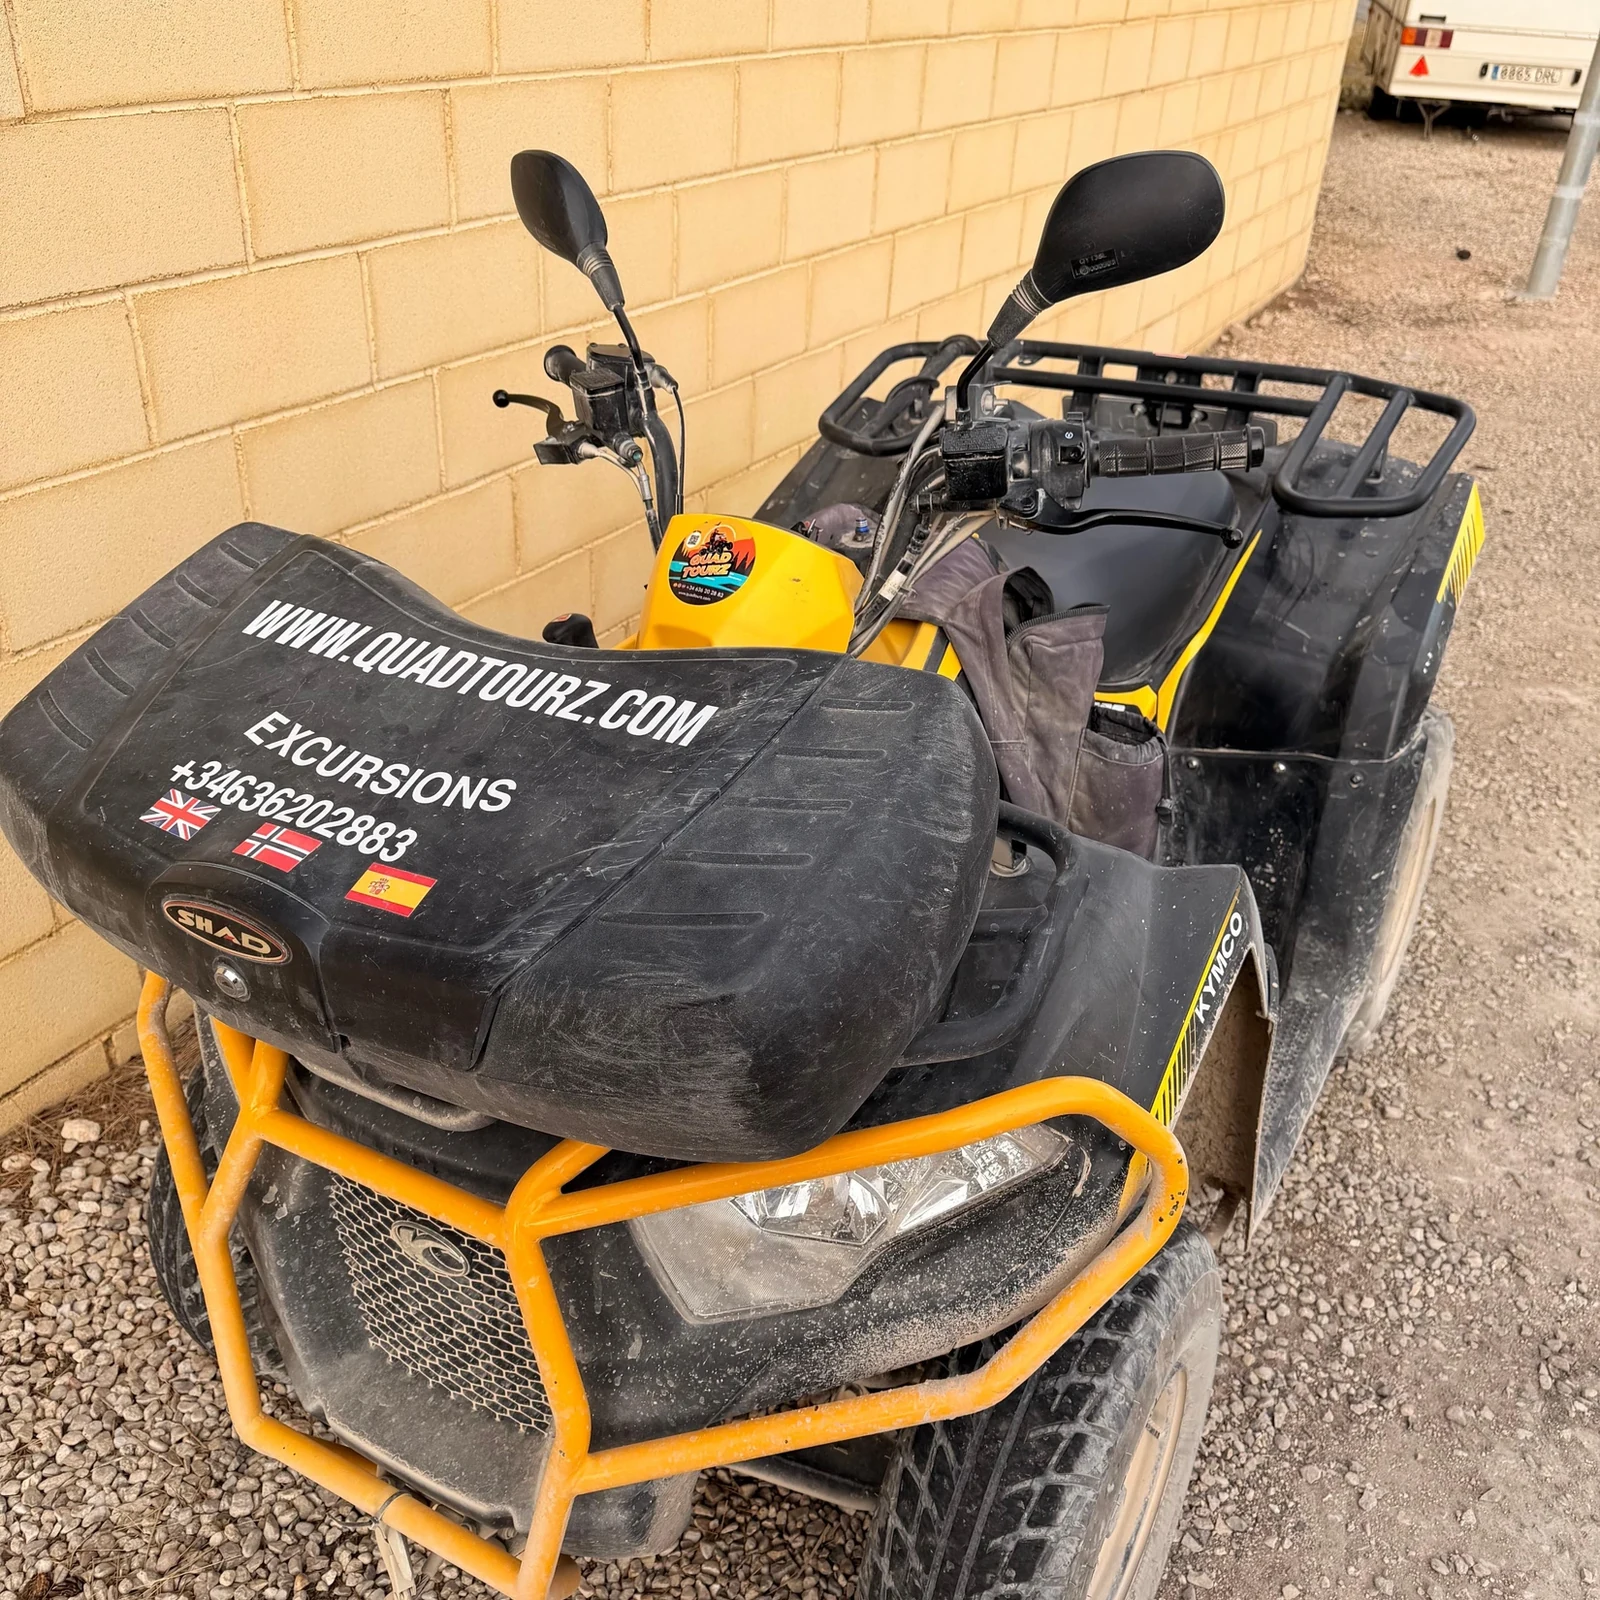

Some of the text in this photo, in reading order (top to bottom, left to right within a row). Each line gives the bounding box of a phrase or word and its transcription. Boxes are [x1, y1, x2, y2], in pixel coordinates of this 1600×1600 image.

[682, 563, 732, 578] TOURZ
[690, 552, 732, 565] QUAD
[242, 600, 718, 747] WWW.QUADTOURZ.COM
[169, 760, 418, 862] +34636202883
[243, 711, 517, 812] EXCURSIONS
[177, 909, 271, 954] SHAD
[1194, 911, 1243, 1024] KYMCO
